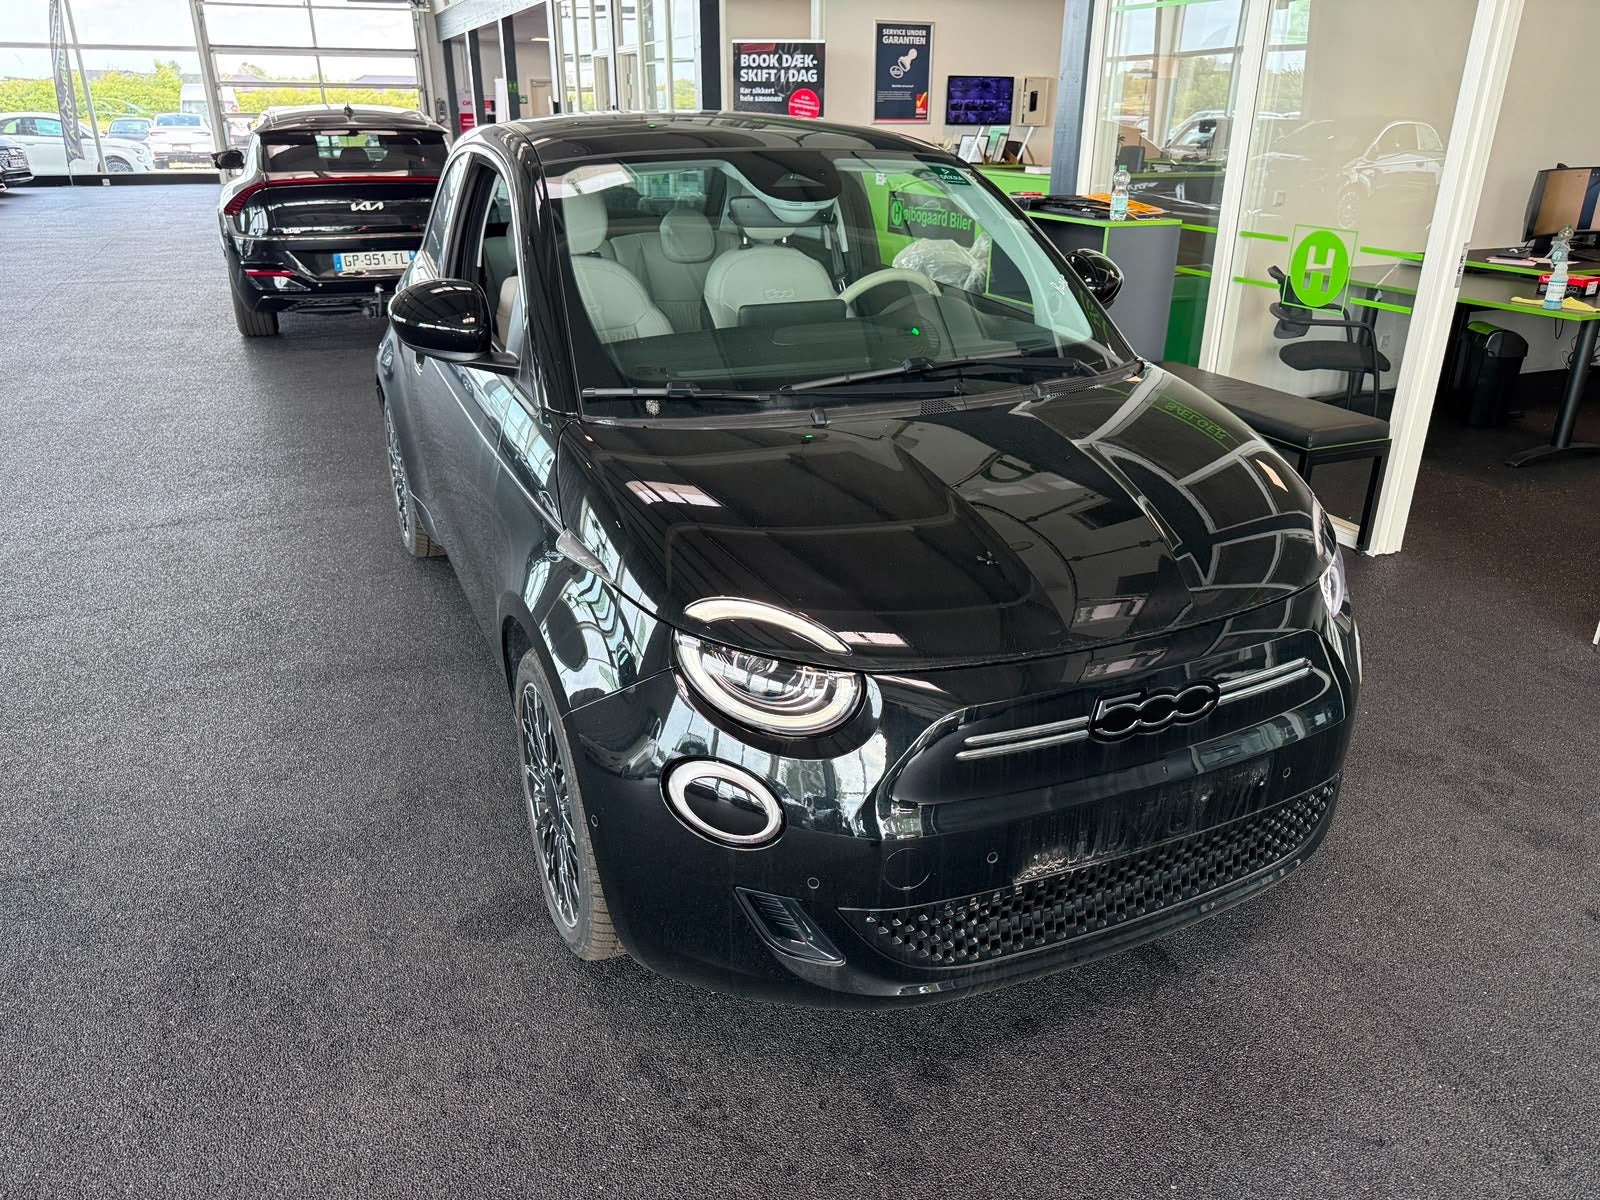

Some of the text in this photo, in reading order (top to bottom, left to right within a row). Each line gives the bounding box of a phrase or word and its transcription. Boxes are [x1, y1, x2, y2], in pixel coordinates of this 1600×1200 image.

[882, 28, 906, 36] SERVICE
[882, 35, 926, 45] GARANTIEN
[740, 54, 818, 67] BOOK DÆK-
[740, 69, 818, 82] SKIFT I DAG
[740, 94, 754, 102] hele
[949, 211, 972, 231] Biler
[344, 252, 409, 267] GP-951-TL
[1302, 245, 1336, 293] H
[1093, 684, 1216, 738] 500
